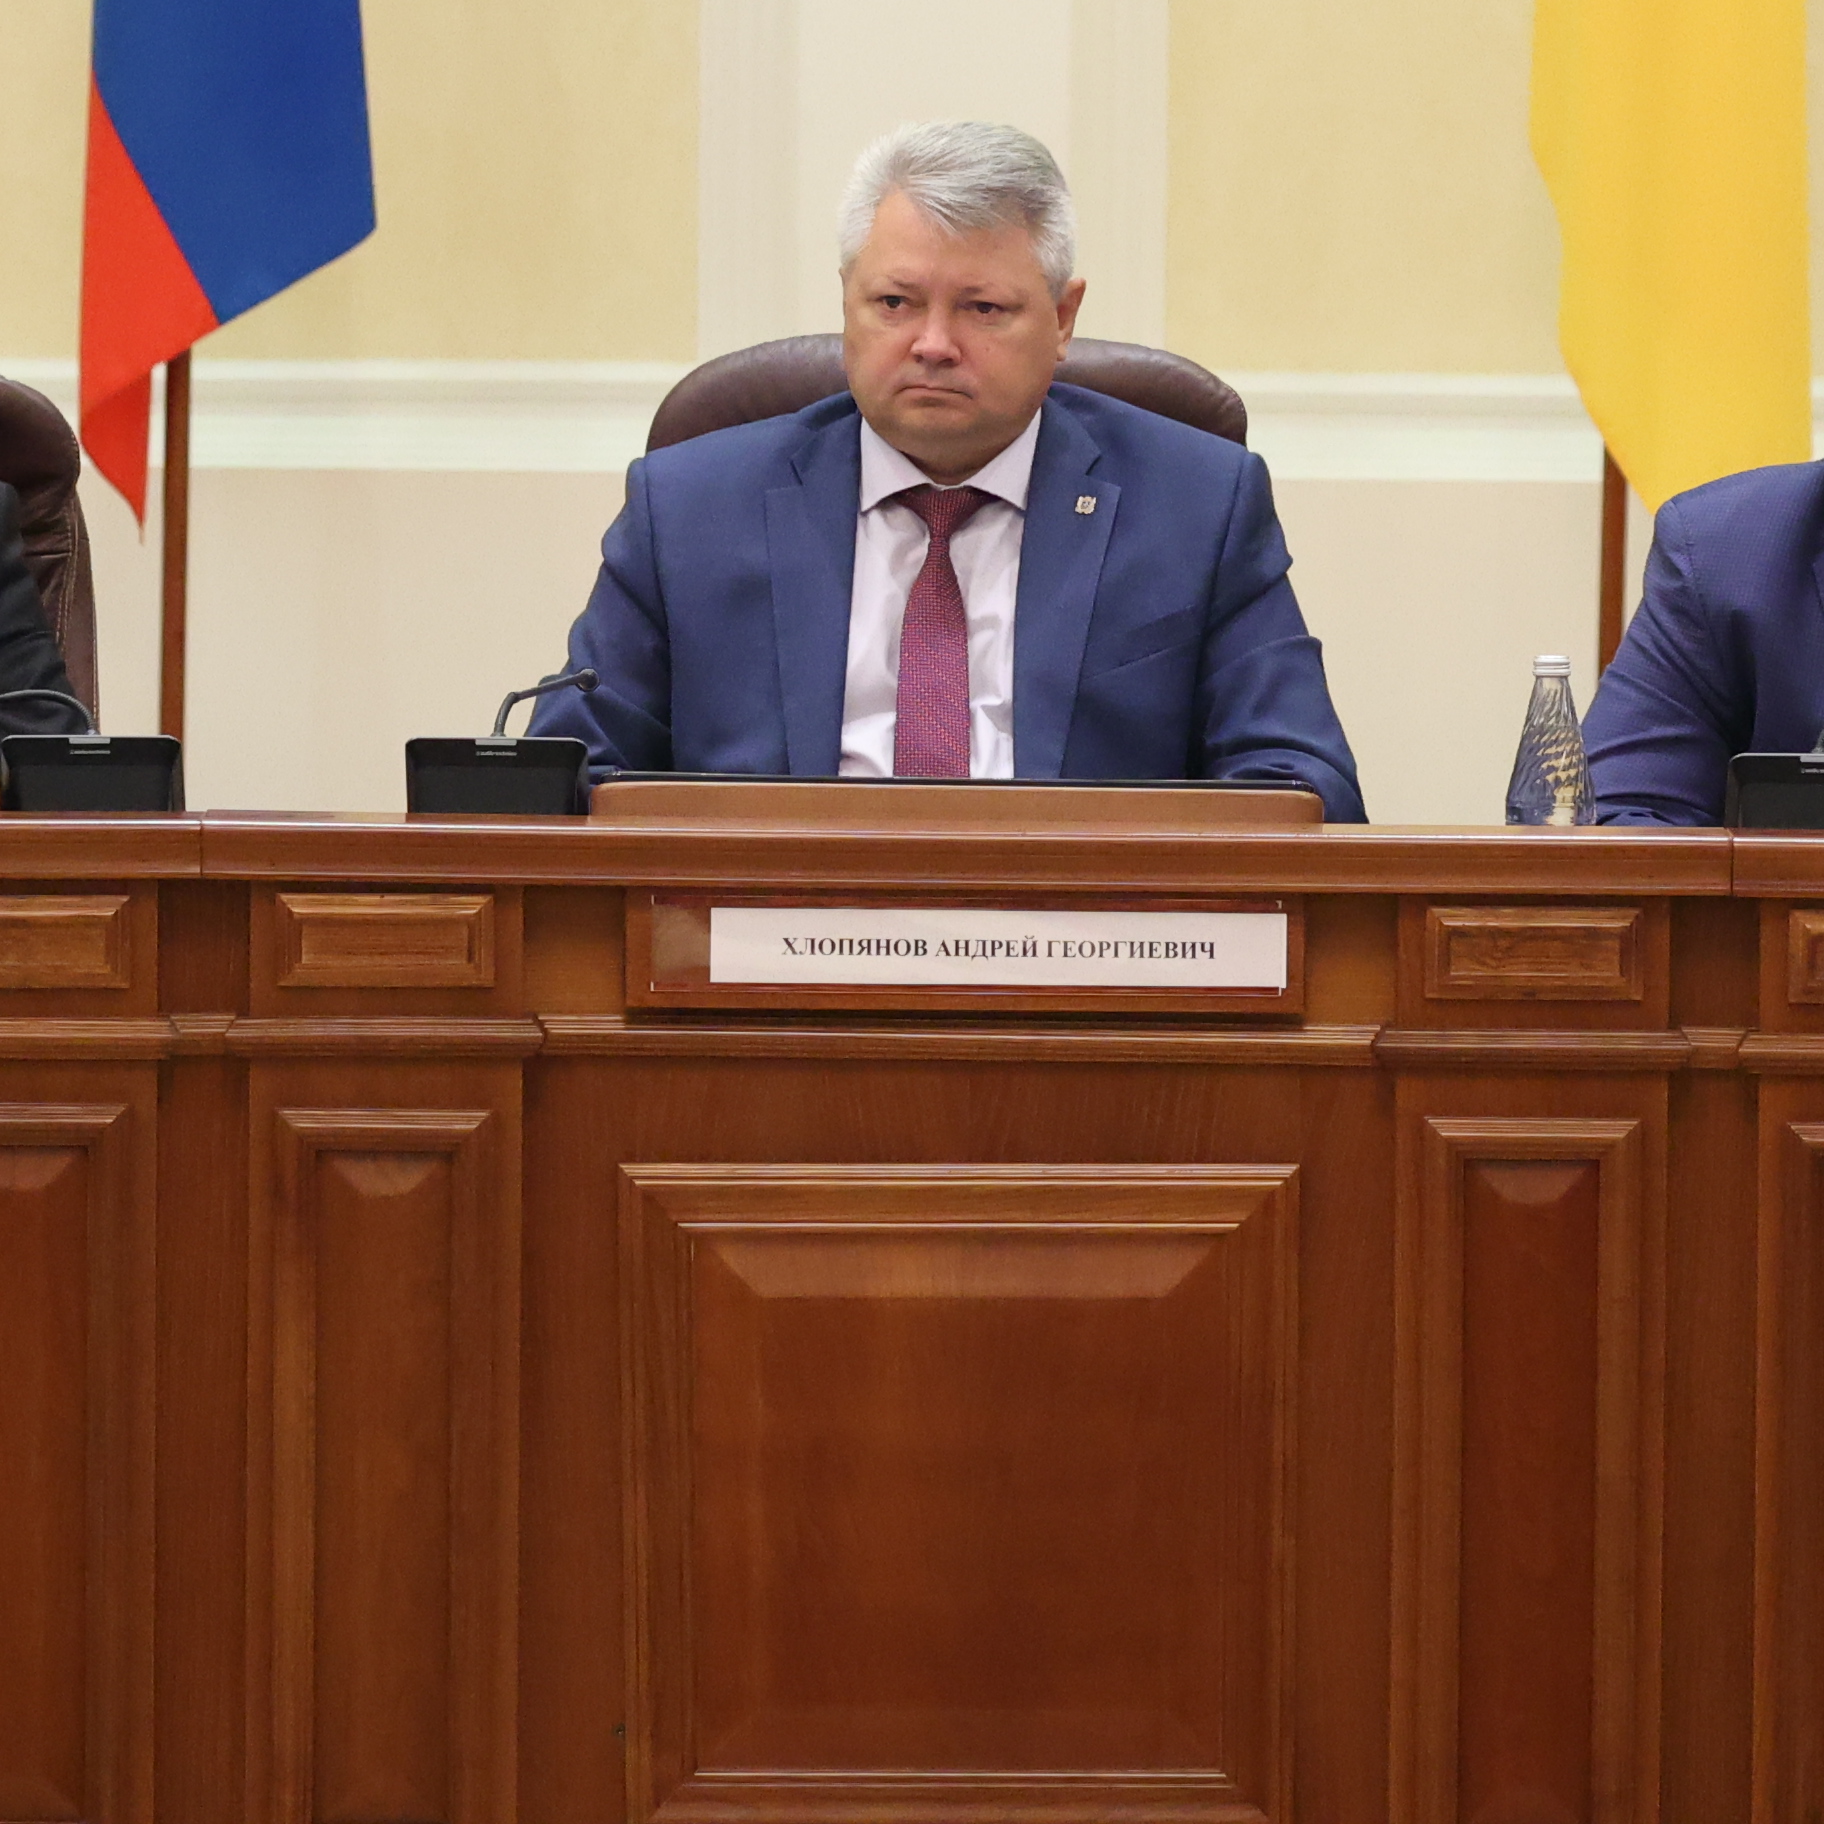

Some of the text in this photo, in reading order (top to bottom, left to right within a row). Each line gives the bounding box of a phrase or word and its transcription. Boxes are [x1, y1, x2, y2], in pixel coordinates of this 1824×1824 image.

[783, 936, 1214, 959] ХЛОПЯНОВ АНДРЕЙ ГЕОРГИЕВИЧ
